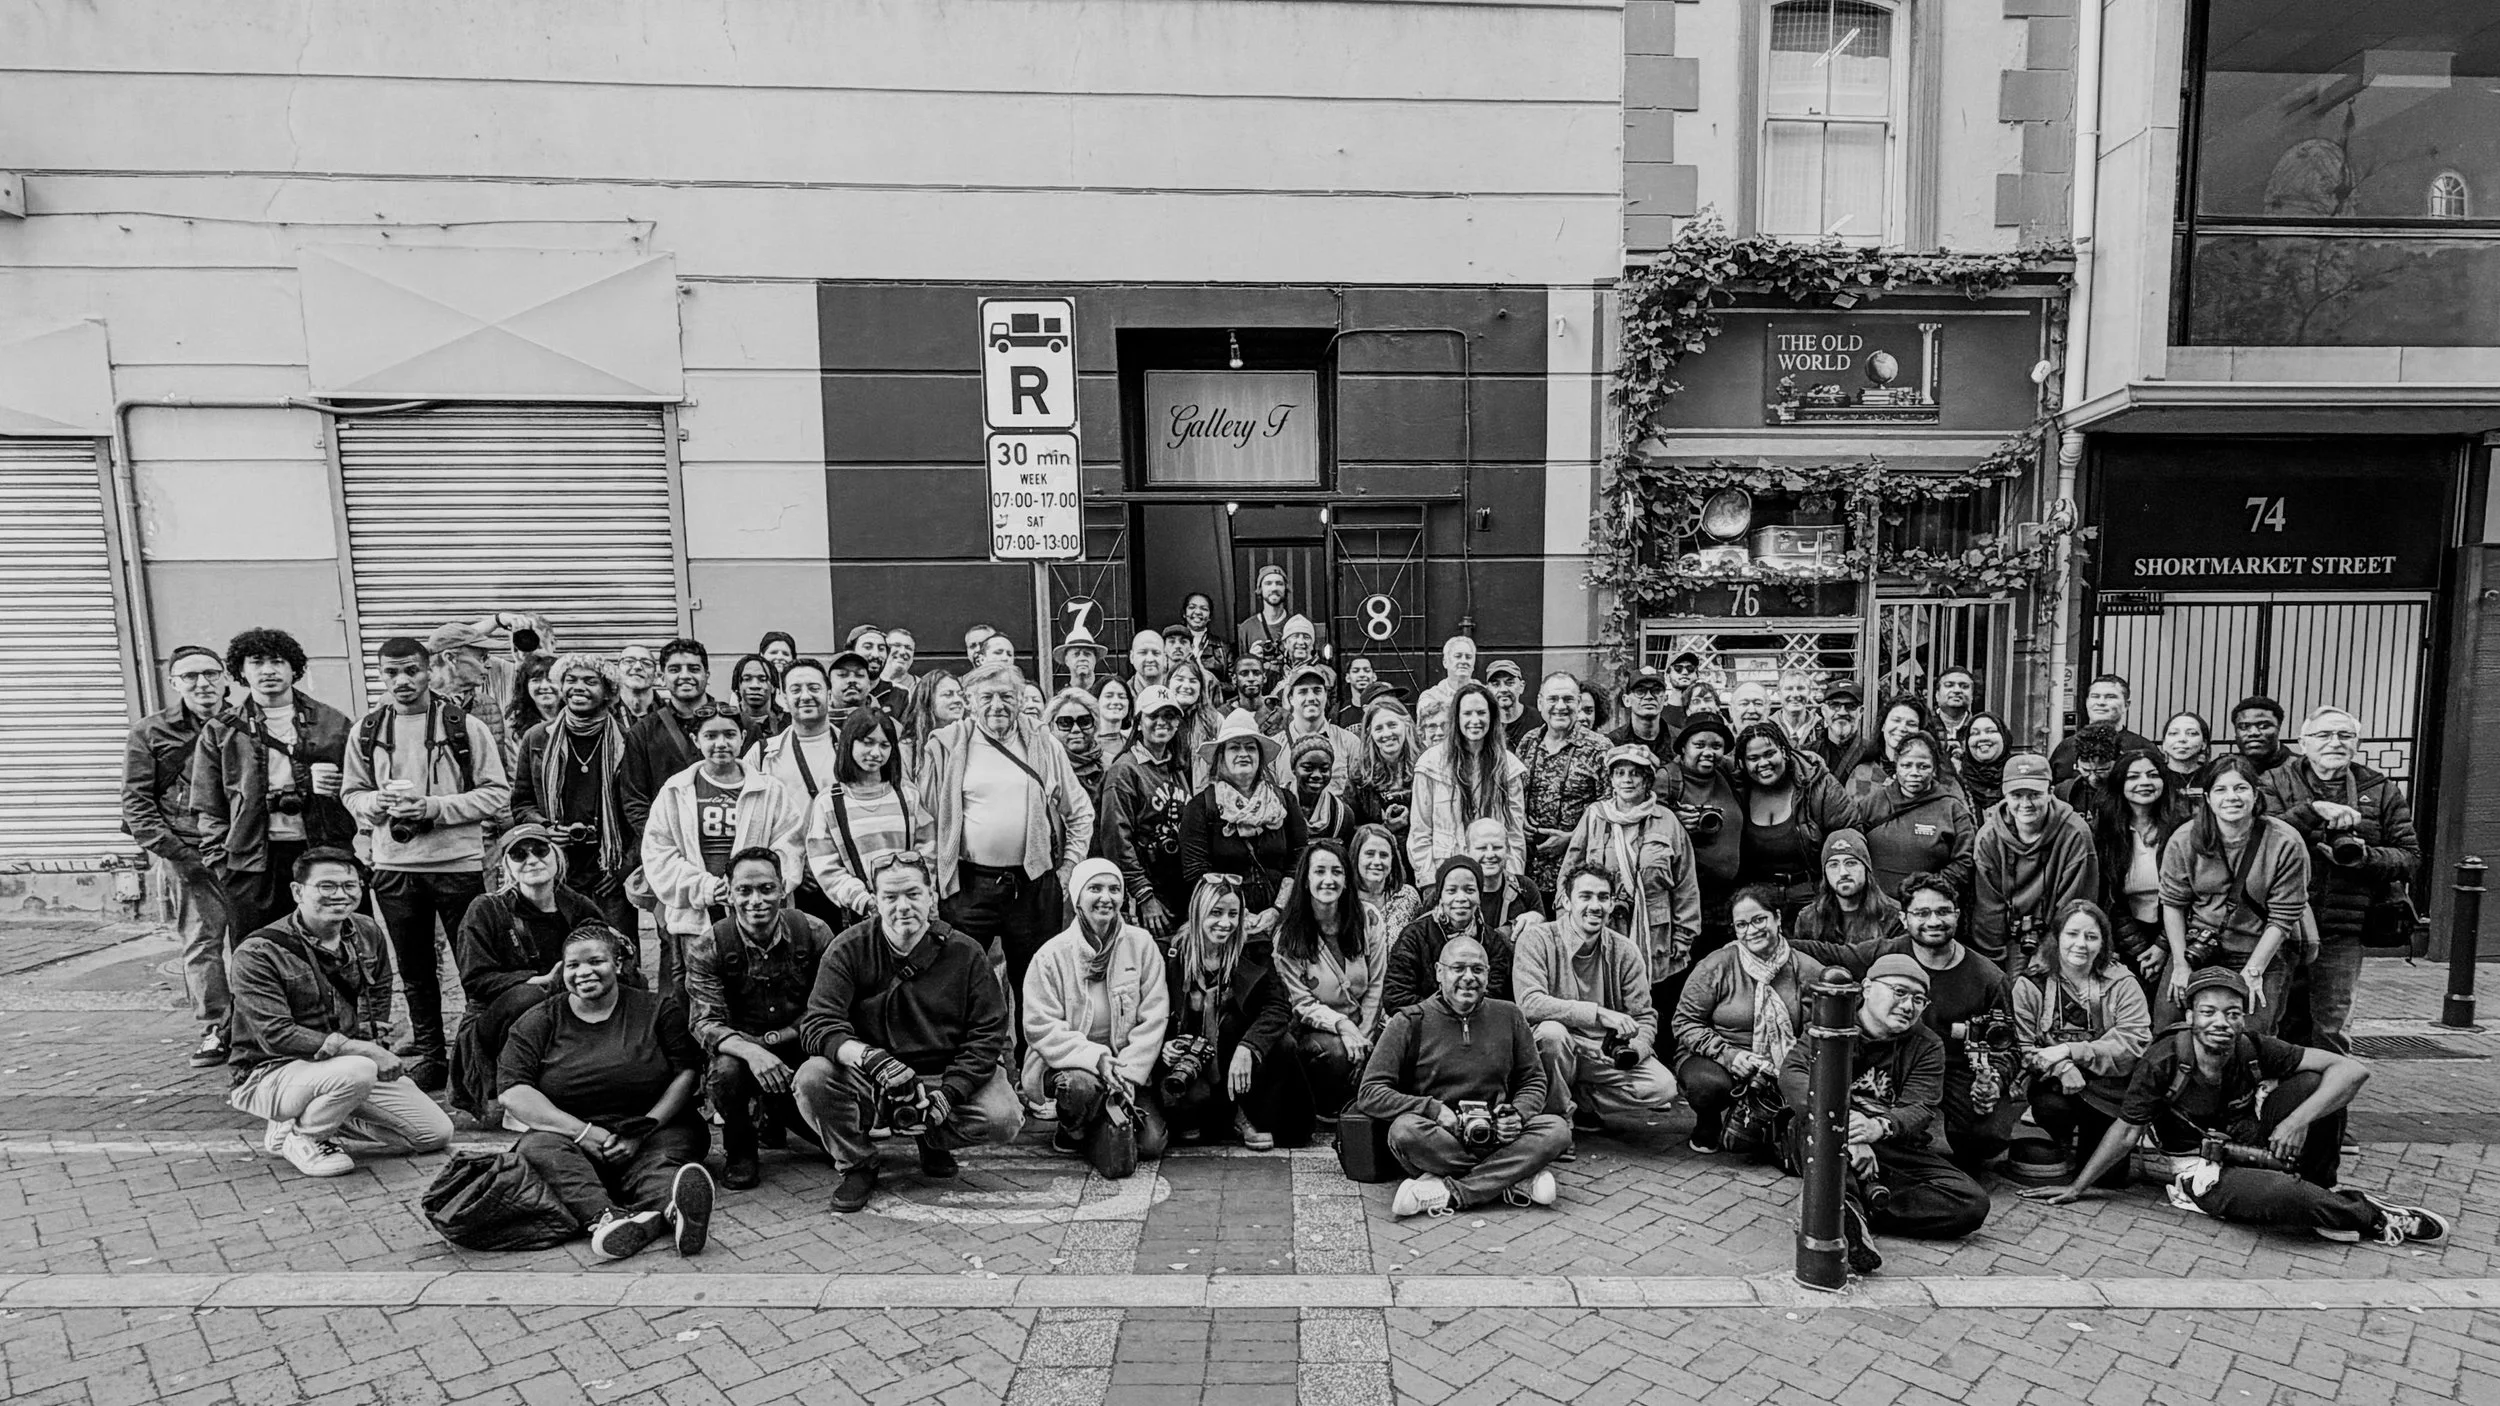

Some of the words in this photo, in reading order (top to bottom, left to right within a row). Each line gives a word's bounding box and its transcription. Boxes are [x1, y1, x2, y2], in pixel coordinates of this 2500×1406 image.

[1777, 334, 1817, 351] THE
[1821, 334, 1863, 351] OLD
[1777, 354, 1851, 371] WORLD
[1010, 365, 1050, 415] R
[1166, 404, 1257, 449] Gallery
[997, 442, 1027, 466] 30
[1037, 449, 1070, 466] min
[1020, 473, 1047, 485] WEEK
[1027, 515, 1044, 527] SAT
[2245, 496, 2287, 533] 74
[2134, 556, 2307, 577] SHORTMARKET
[2310, 555, 2397, 575] STREET
[1727, 584, 1760, 617] 76
[1067, 601, 1093, 629] 7
[1366, 595, 1393, 641] 8
